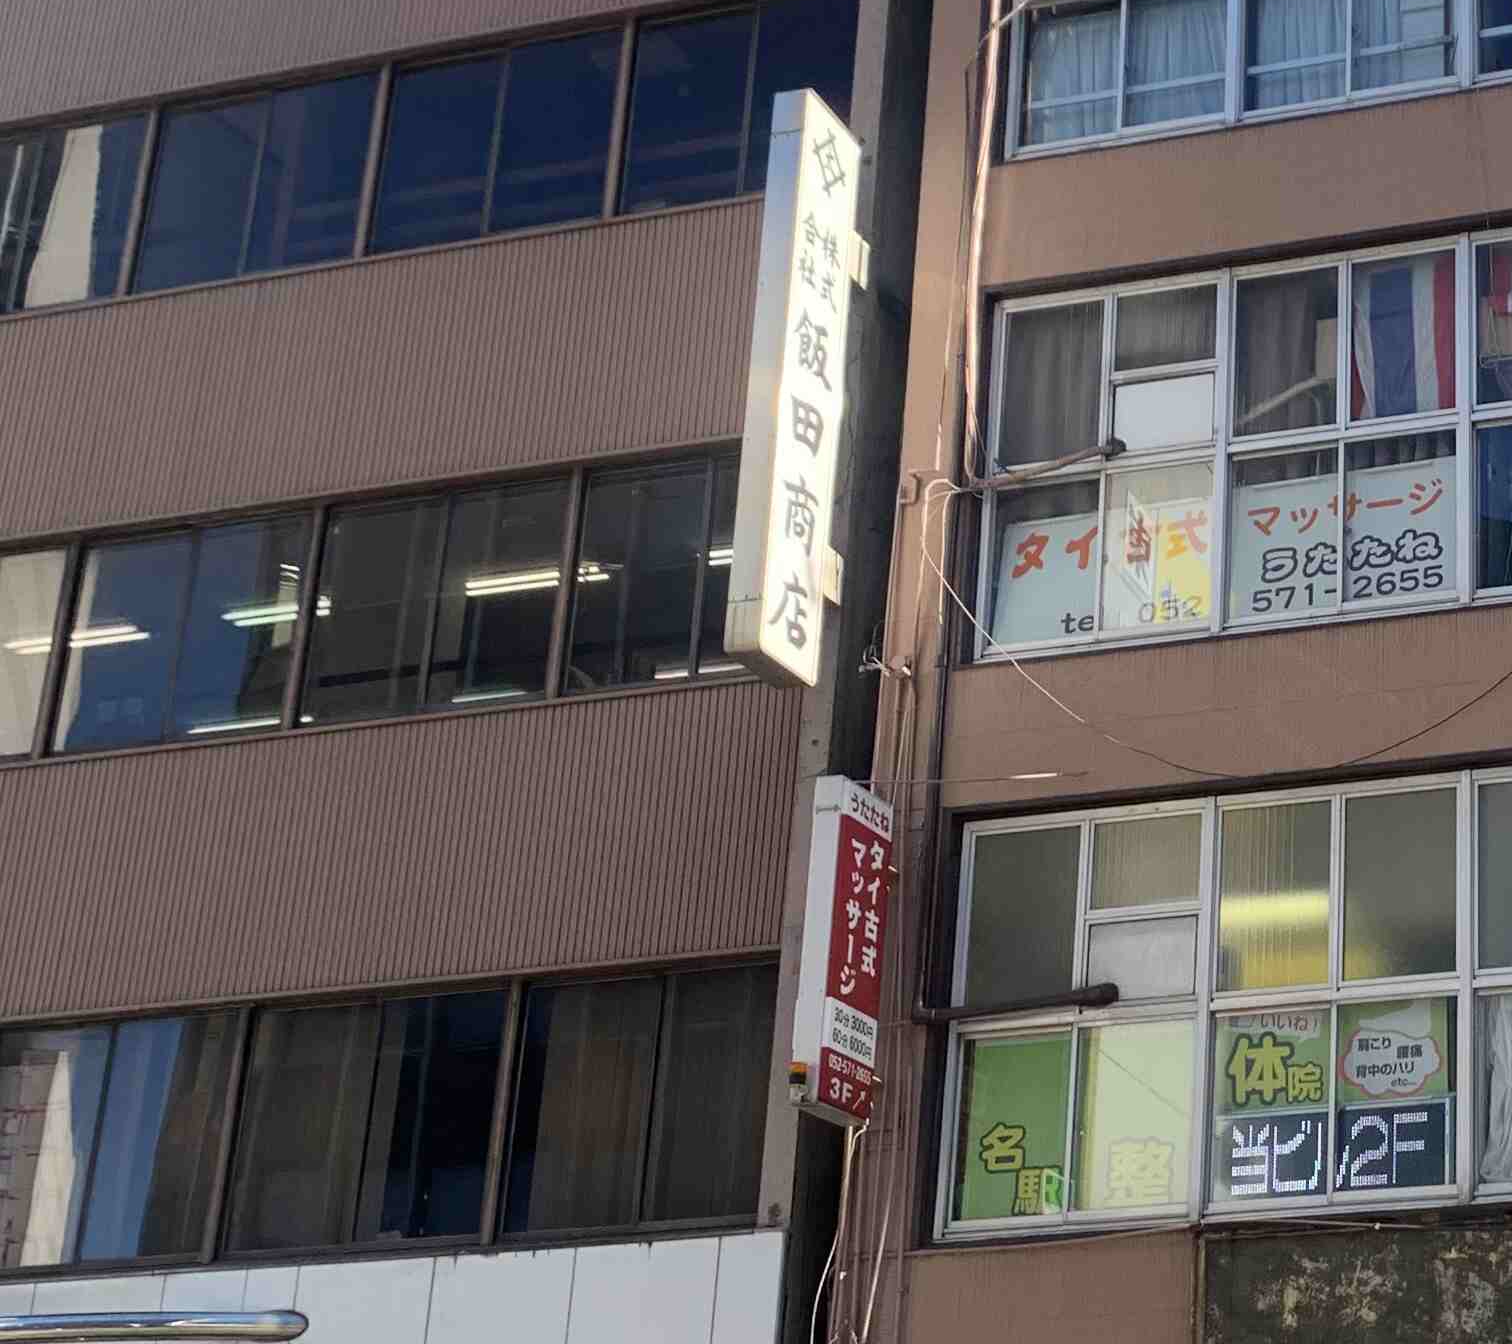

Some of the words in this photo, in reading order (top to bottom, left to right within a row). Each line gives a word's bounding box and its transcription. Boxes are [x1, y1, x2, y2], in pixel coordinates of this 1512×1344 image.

[769, 307, 832, 650] 飯田商店
[1248, 478, 1443, 536] マッサージ
[1261, 529, 1444, 583] うたたね
[851, 792, 889, 834] うたたね
[840, 837, 867, 997] マッサージ
[861, 840, 885, 979] タイ古式
[829, 1077, 854, 1104] 3F
